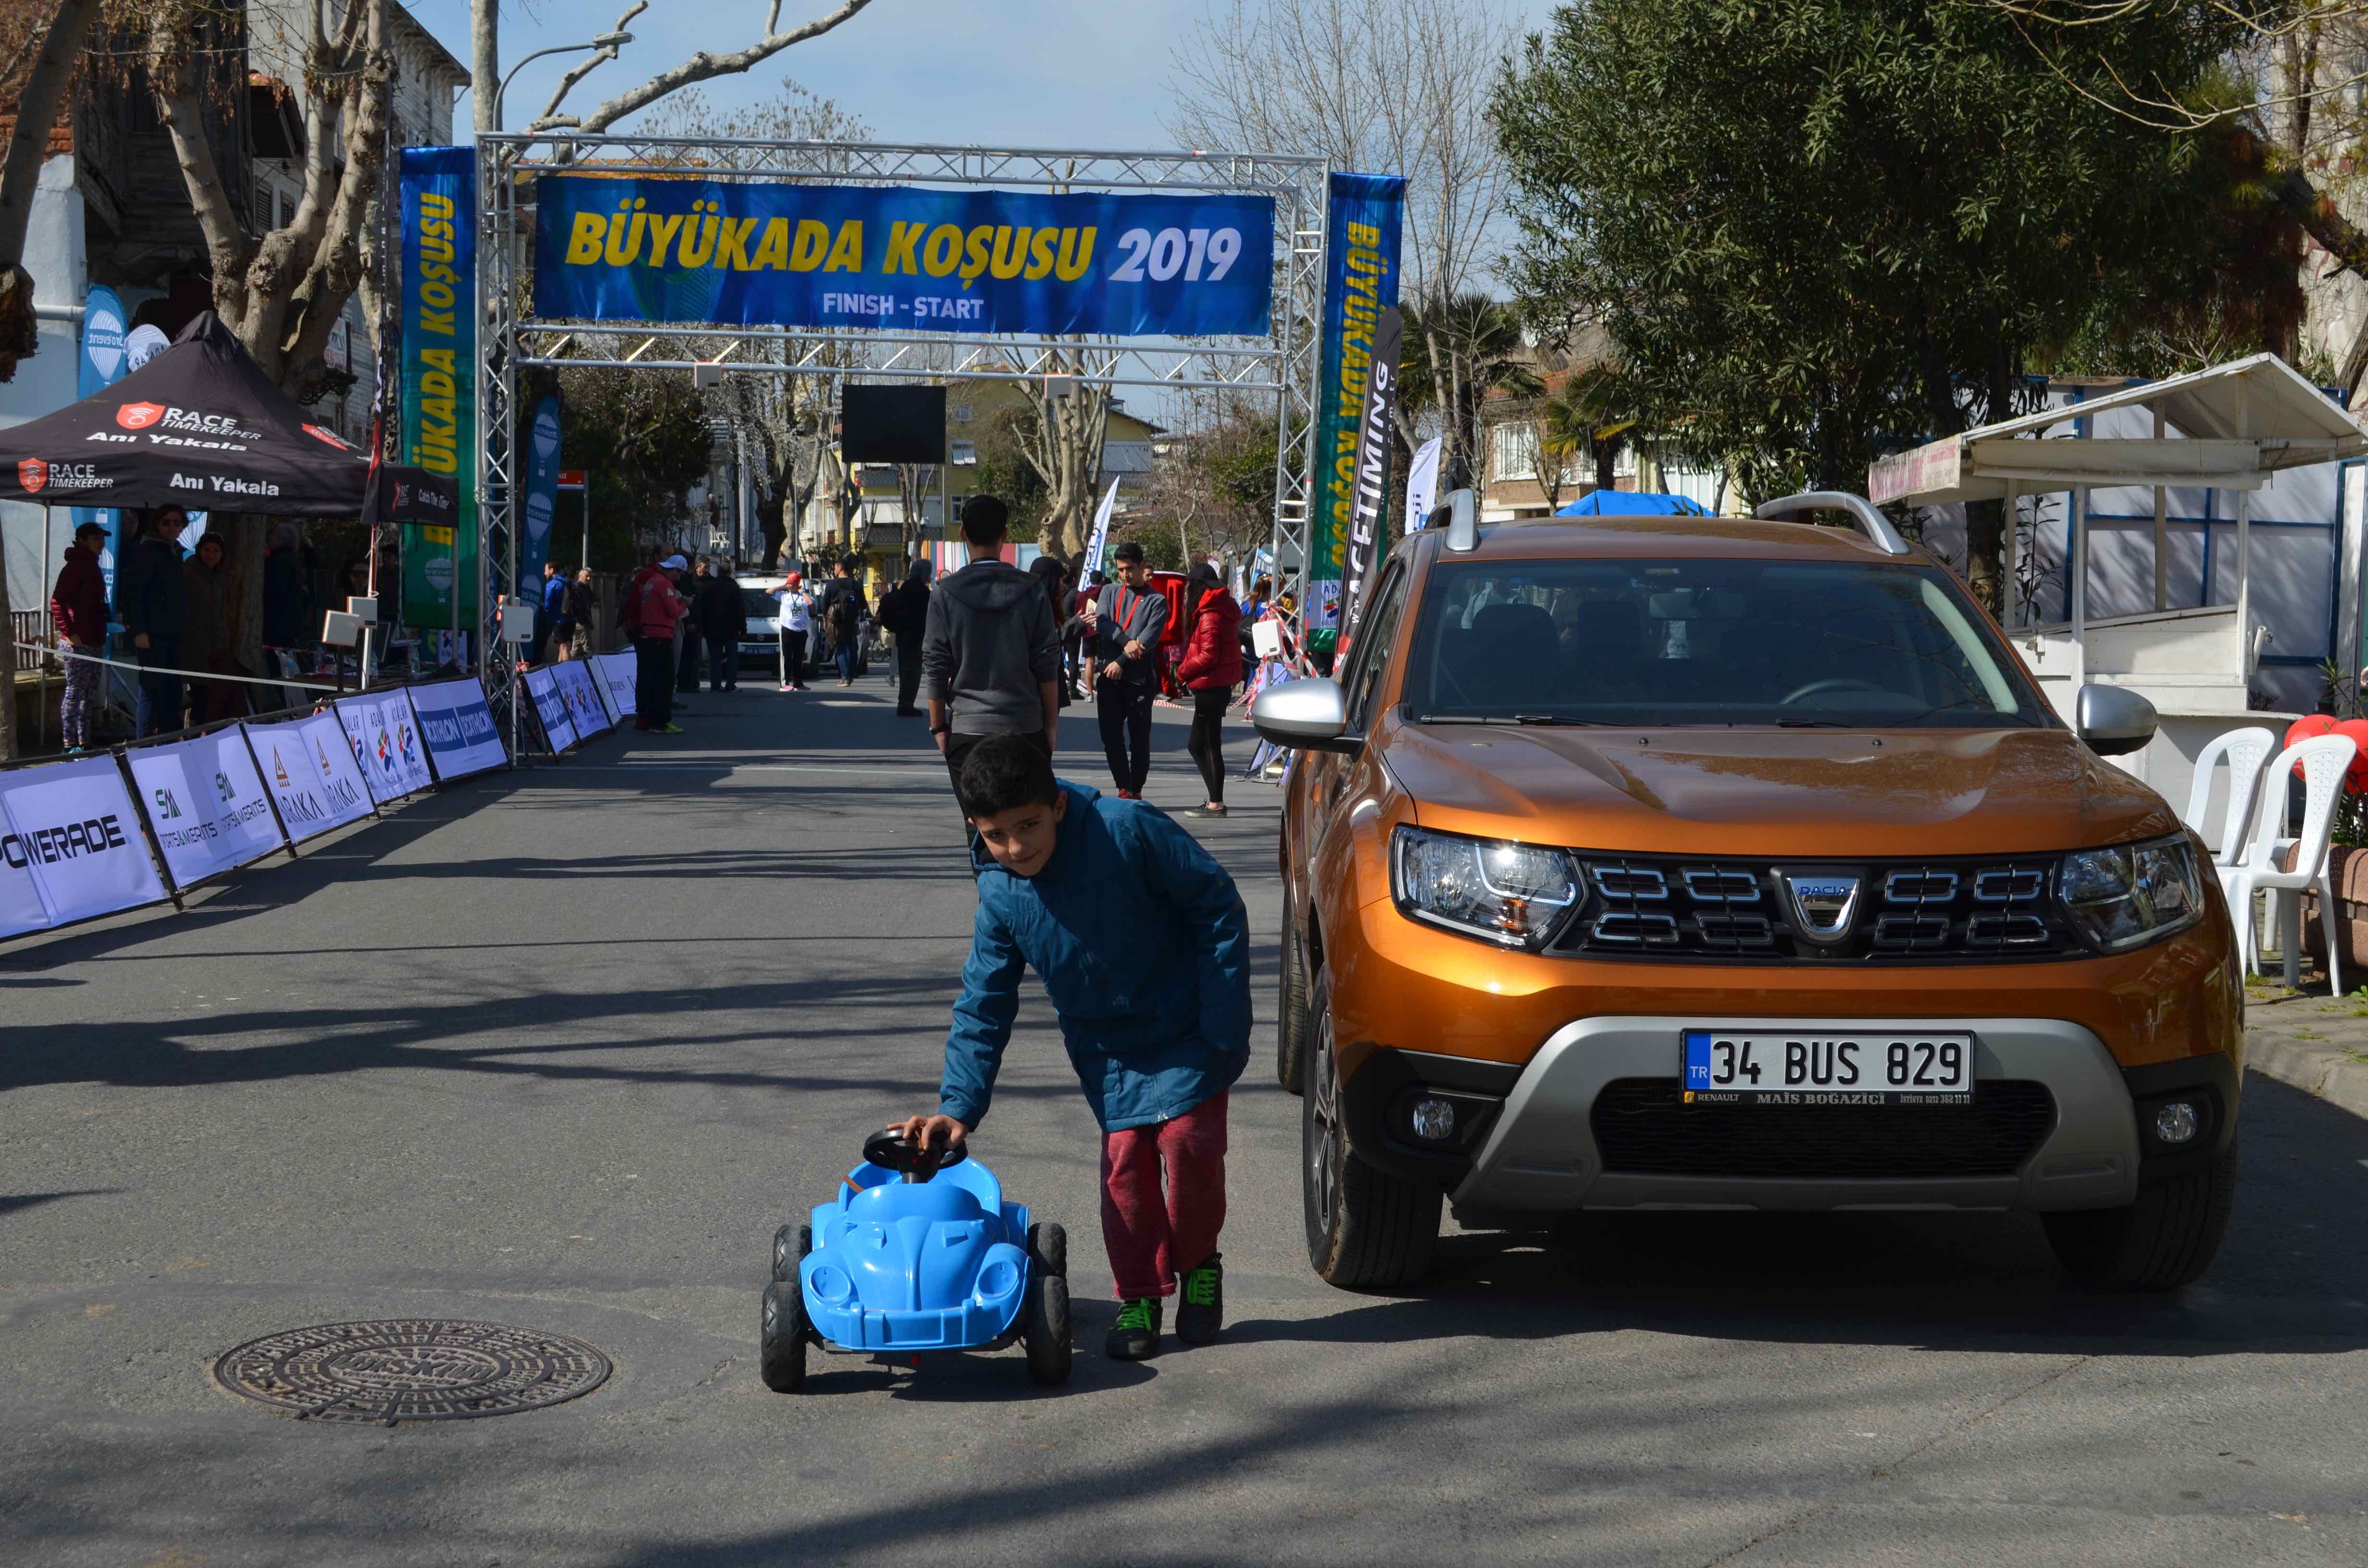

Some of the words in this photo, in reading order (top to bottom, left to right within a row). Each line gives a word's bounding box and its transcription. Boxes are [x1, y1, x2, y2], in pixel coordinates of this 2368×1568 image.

[565, 197, 863, 272] BÜYÜKADA
[882, 220, 1098, 290] KOŞUSU
[1108, 227, 1242, 282] 2019
[420, 192, 463, 336] KOŞUSU
[823, 293, 894, 315] FINISH
[914, 295, 984, 318] START
[165, 407, 237, 429] RACE
[160, 419, 262, 441] TIMEKEEPER
[86, 431, 137, 442] Anı
[148, 434, 247, 452] Yakala
[49, 464, 95, 478] RACE
[49, 478, 113, 489] TIMEKEEPER
[169, 473, 203, 490] Anı
[211, 476, 279, 496] Yakala
[0, 814, 126, 869] OWERADE
[1800, 886, 1848, 895] DACIA
[1690, 1066, 1708, 1078] TR
[1712, 1040, 1761, 1084] 34
[1785, 1041, 1860, 1085] BUS
[1887, 1041, 1961, 1085] 829
